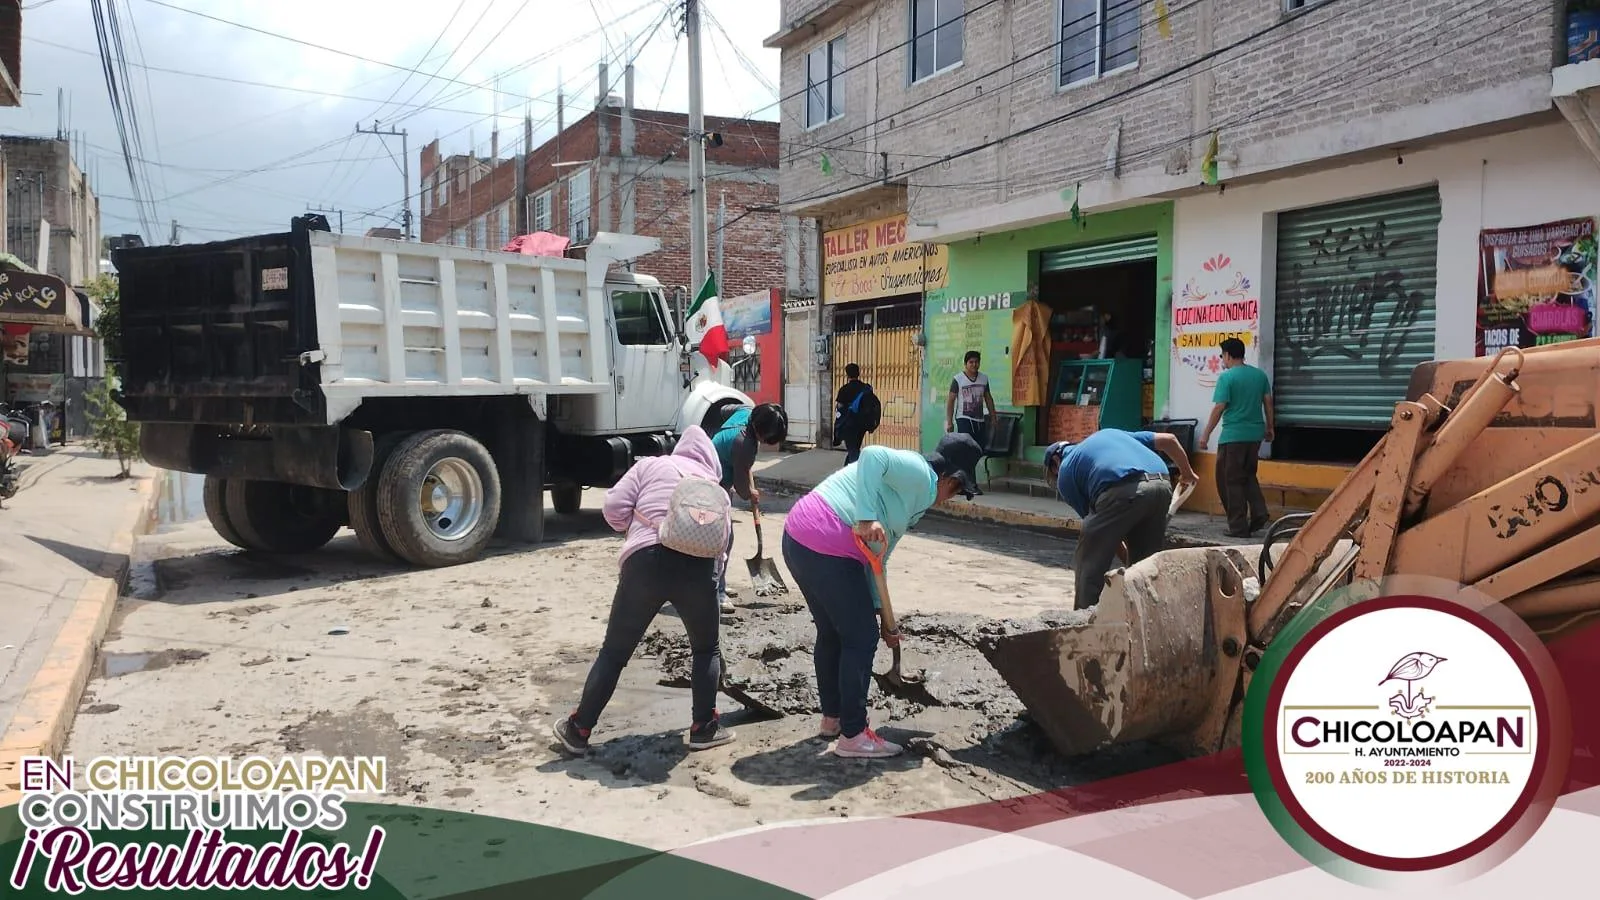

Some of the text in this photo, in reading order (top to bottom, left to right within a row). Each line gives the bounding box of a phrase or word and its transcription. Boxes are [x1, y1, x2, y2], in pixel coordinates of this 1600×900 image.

[824, 227, 868, 258] TALLER
[1484, 220, 1592, 246] DISFRUTA DE UNA VARIEDAD EN
[860, 255, 867, 269] EN
[869, 251, 888, 267] AUTOS
[892, 242, 938, 262] AMERICANOS
[15, 285, 39, 303] RCA
[1176, 300, 1258, 325] COCINA ECONOMICA
[1531, 311, 1578, 329] CHAROLAS
[1183, 334, 1201, 347] SAN
[1485, 329, 1507, 346] TACOS
[1509, 328, 1520, 344] DE
